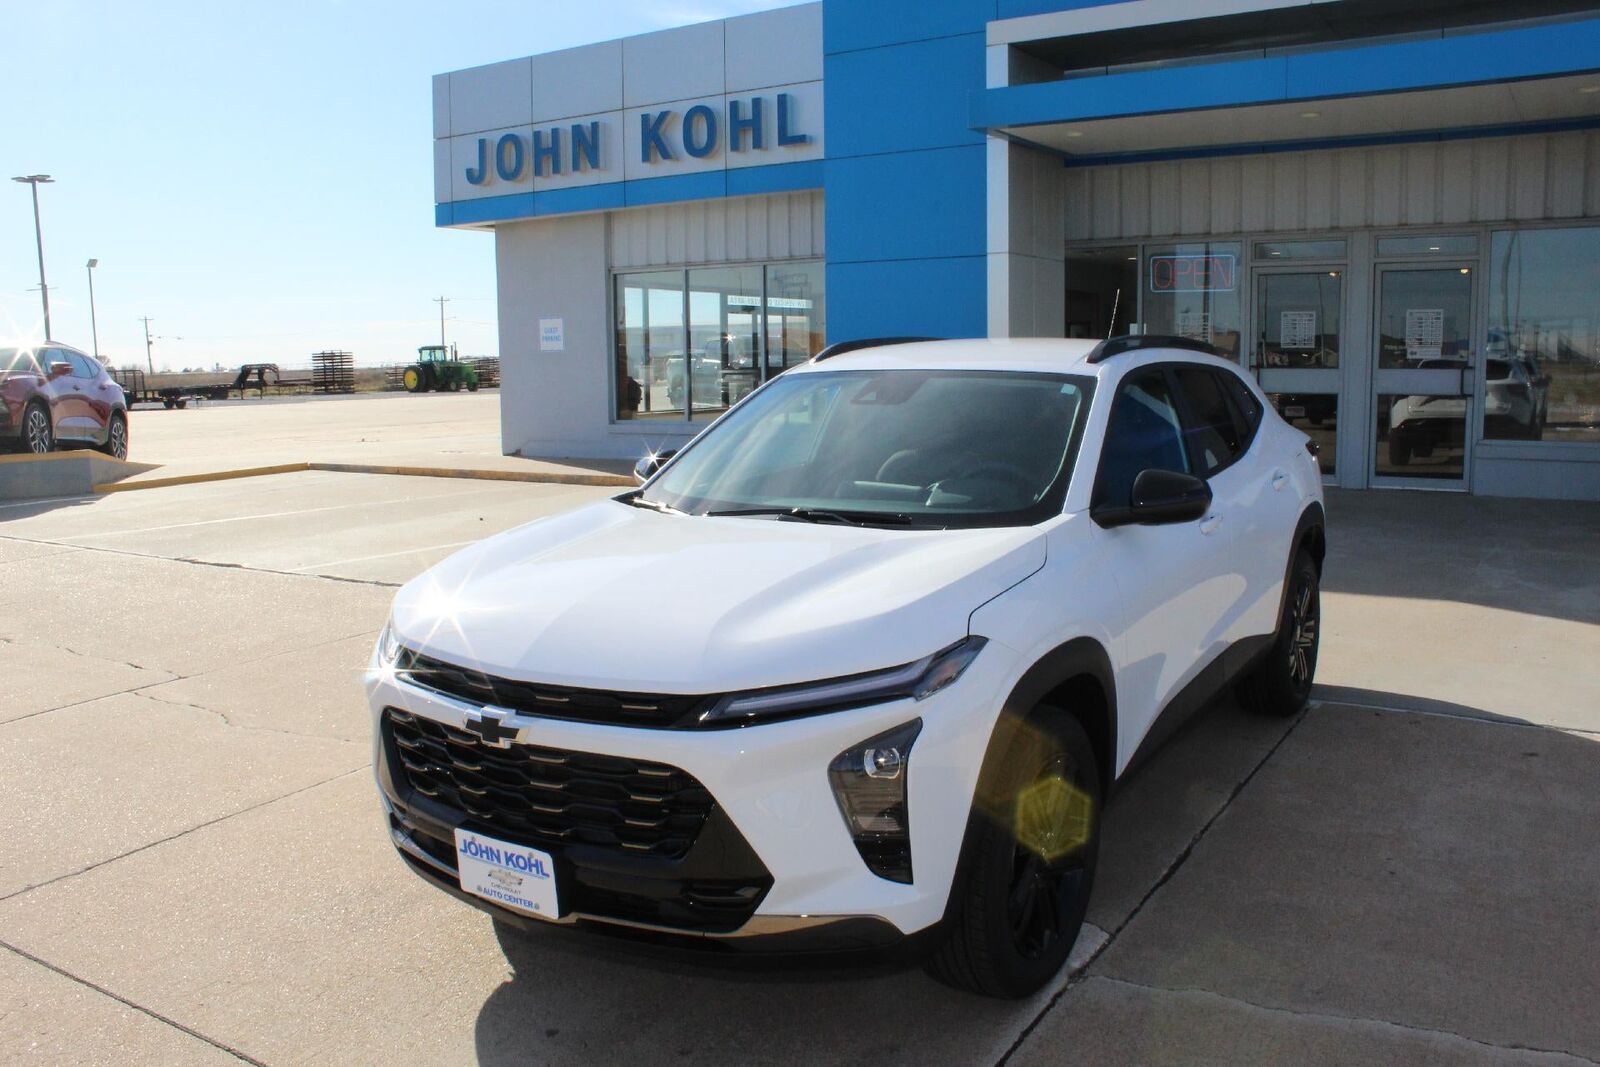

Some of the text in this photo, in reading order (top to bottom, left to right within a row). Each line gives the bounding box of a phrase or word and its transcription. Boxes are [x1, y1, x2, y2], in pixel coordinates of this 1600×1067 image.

[466, 93, 808, 186] JOHN KOHL
[1154, 258, 1232, 289] OPEN
[459, 839, 550, 878] JOHN KOHL
[483, 887, 534, 909] AUTO CENTER
